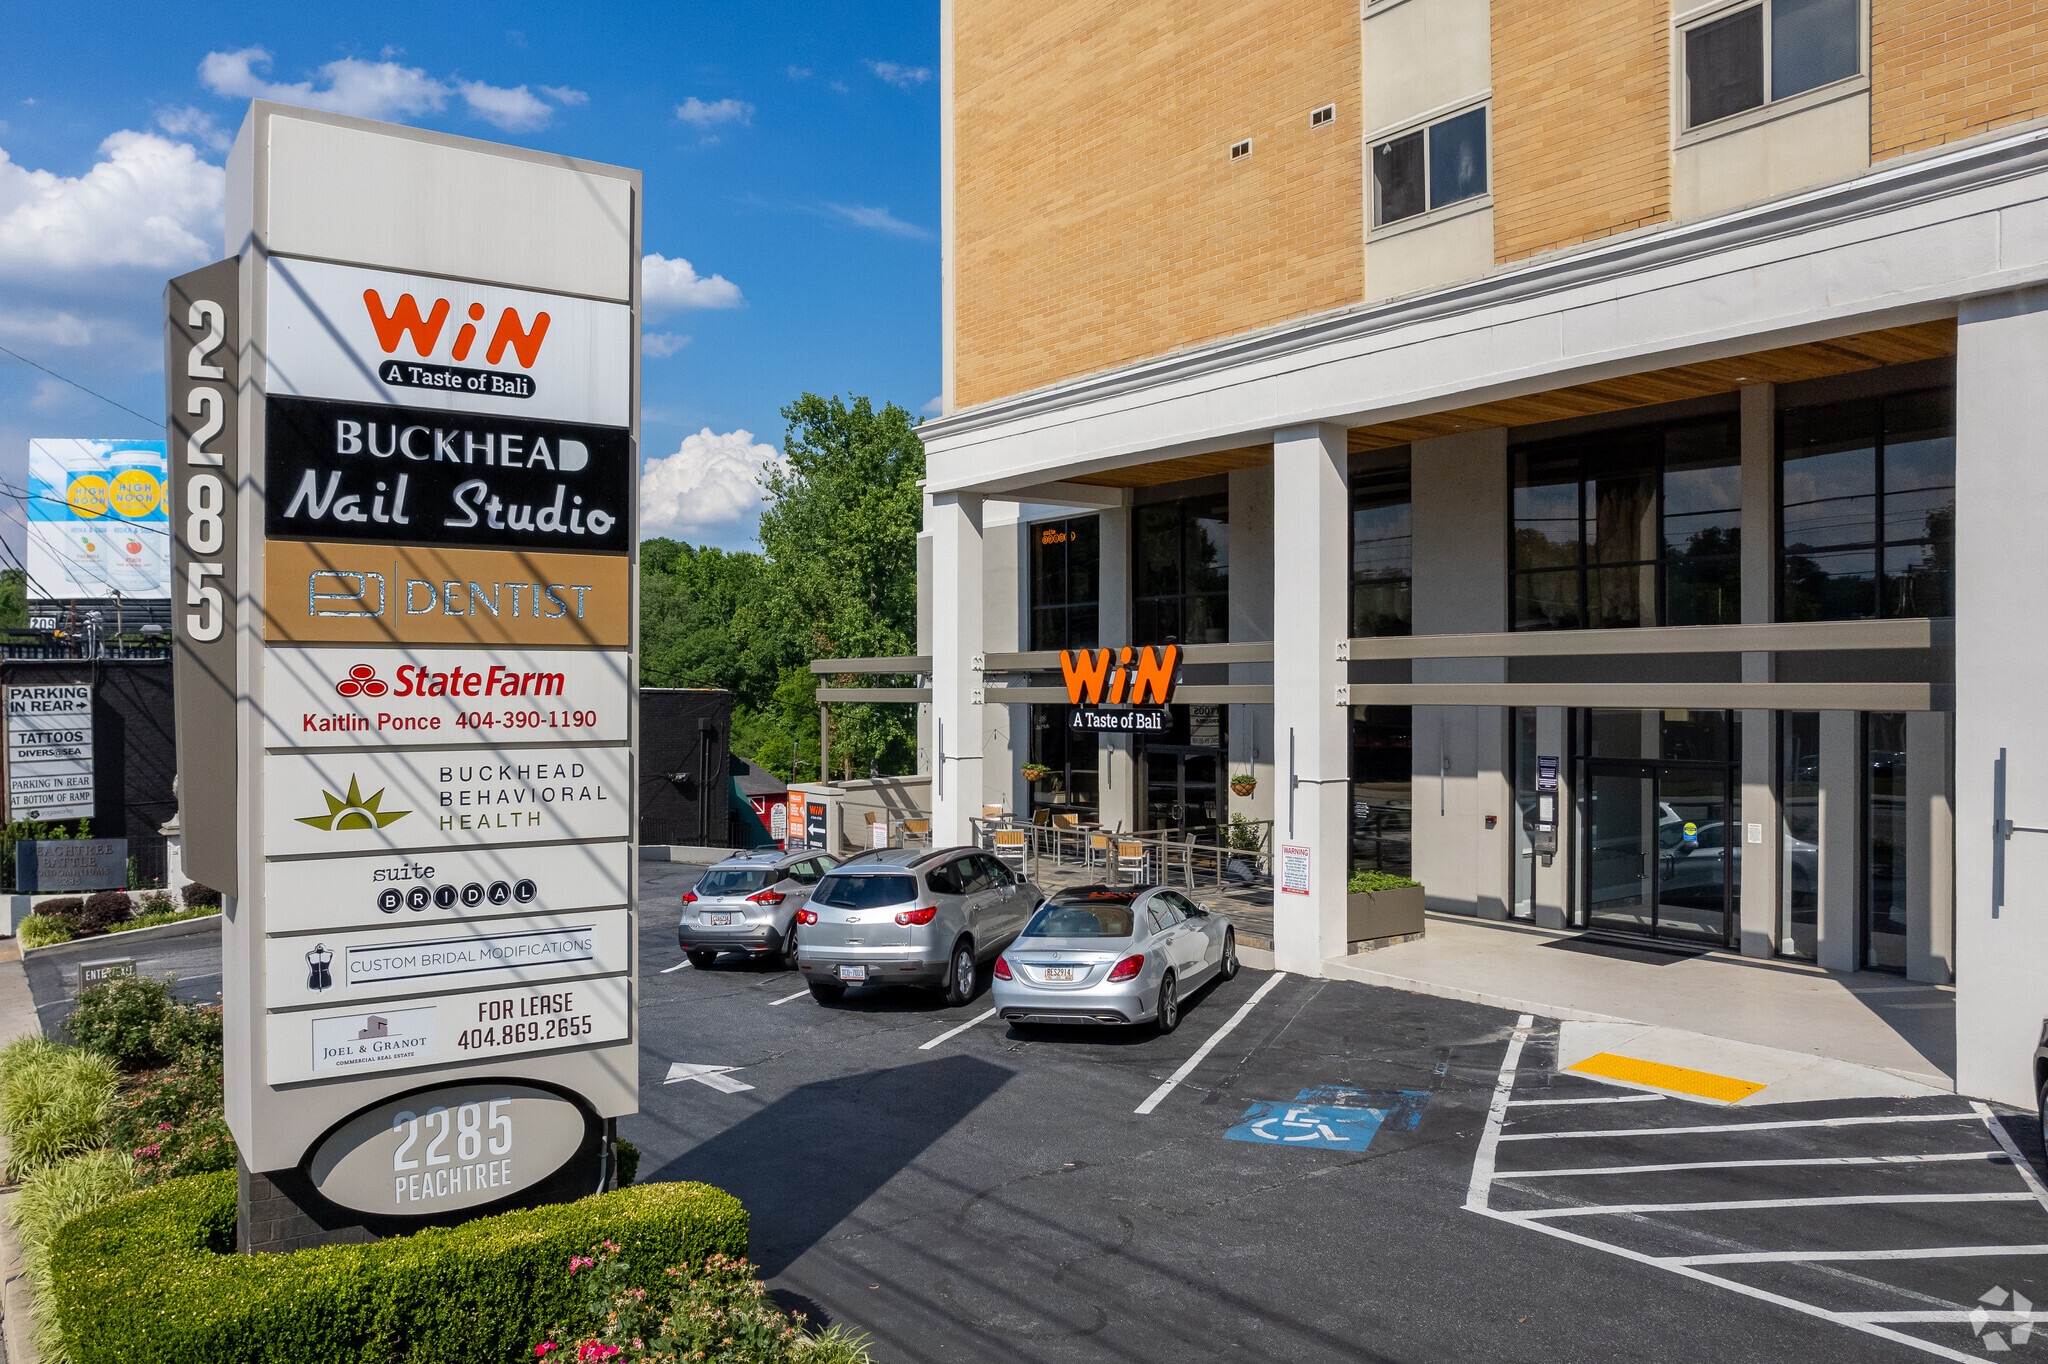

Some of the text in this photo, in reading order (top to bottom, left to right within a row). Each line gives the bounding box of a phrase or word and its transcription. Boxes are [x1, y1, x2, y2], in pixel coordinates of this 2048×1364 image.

[363, 288, 551, 369] WiN
[386, 364, 529, 396] A Taste of Bali
[336, 418, 590, 472] BUCKHEAD
[186, 299, 226, 642] 2285
[75, 487, 105, 495] HIGH
[119, 483, 152, 492] HIGH
[73, 497, 106, 505] NOON
[116, 494, 153, 502] NOON
[283, 468, 617, 536] Nail Studio
[406, 578, 593, 620] DENTIST
[31, 618, 55, 629] 209
[1059, 644, 1182, 705] WiN
[11, 687, 88, 699] PARKING
[10, 700, 73, 713] IN REAR
[302, 710, 597, 732] Kaitlin Ponce 404-390-1190
[1072, 712, 1162, 730] A Taste of Bali
[18, 731, 84, 744] TATTOOS
[18, 748, 82, 758] DIVERS@SEA
[439, 763, 586, 783] BUCKHEAD
[12, 777, 90, 790] PARKING IN REAR
[11, 792, 90, 805] AT BOTTOM OF RAMP
[439, 785, 608, 807] BEHAVIORAL
[439, 811, 542, 831] HEALTH
[34, 844, 114, 856] EACHTREE
[1283, 847, 1309, 857] WARNING
[44, 856, 98, 869] BATTLE
[372, 862, 436, 883] suite
[379, 880, 535, 912] BRIDAL
[350, 938, 593, 974] CUSTOM BRIDAL MODIFICATIONS
[478, 992, 574, 1023] FOR LEASE
[457, 1014, 593, 1050] 404.869.2655
[335, 1058, 375, 1067] COMMERCIAL
[393, 1051, 415, 1059] ESTATE
[359, 1044, 367, 1054] &
[392, 1096, 513, 1172] 2285
[394, 1158, 512, 1204] PEACHTREE
